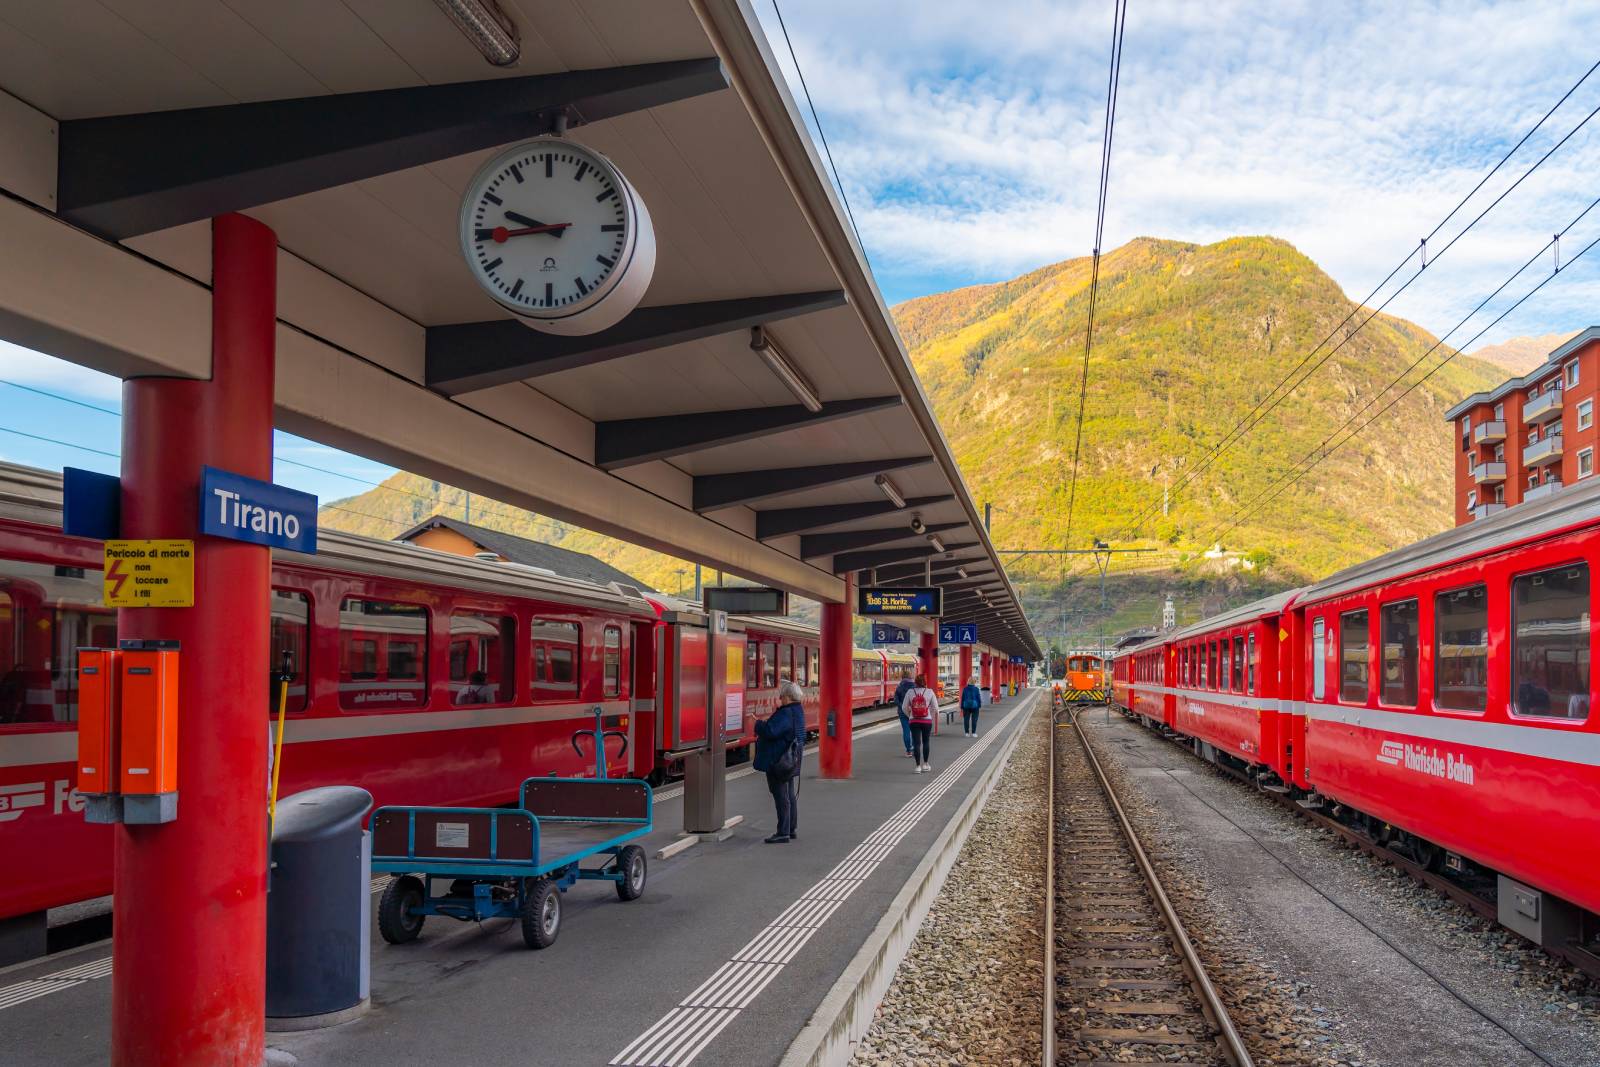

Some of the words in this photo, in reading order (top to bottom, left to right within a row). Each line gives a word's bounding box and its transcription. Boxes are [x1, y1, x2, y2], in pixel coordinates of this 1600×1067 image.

[214, 488, 300, 539] Tirano
[106, 549, 146, 558] Pericolo
[149, 549, 158, 558] di
[161, 549, 190, 558] morte
[135, 577, 169, 585] toccare
[878, 631, 886, 641] 3
[896, 631, 905, 640] A
[944, 631, 953, 640] 4
[963, 631, 972, 640] A
[1328, 628, 1334, 657] 2
[1405, 743, 1446, 778] Rhätische
[1447, 752, 1474, 785] Bahn
